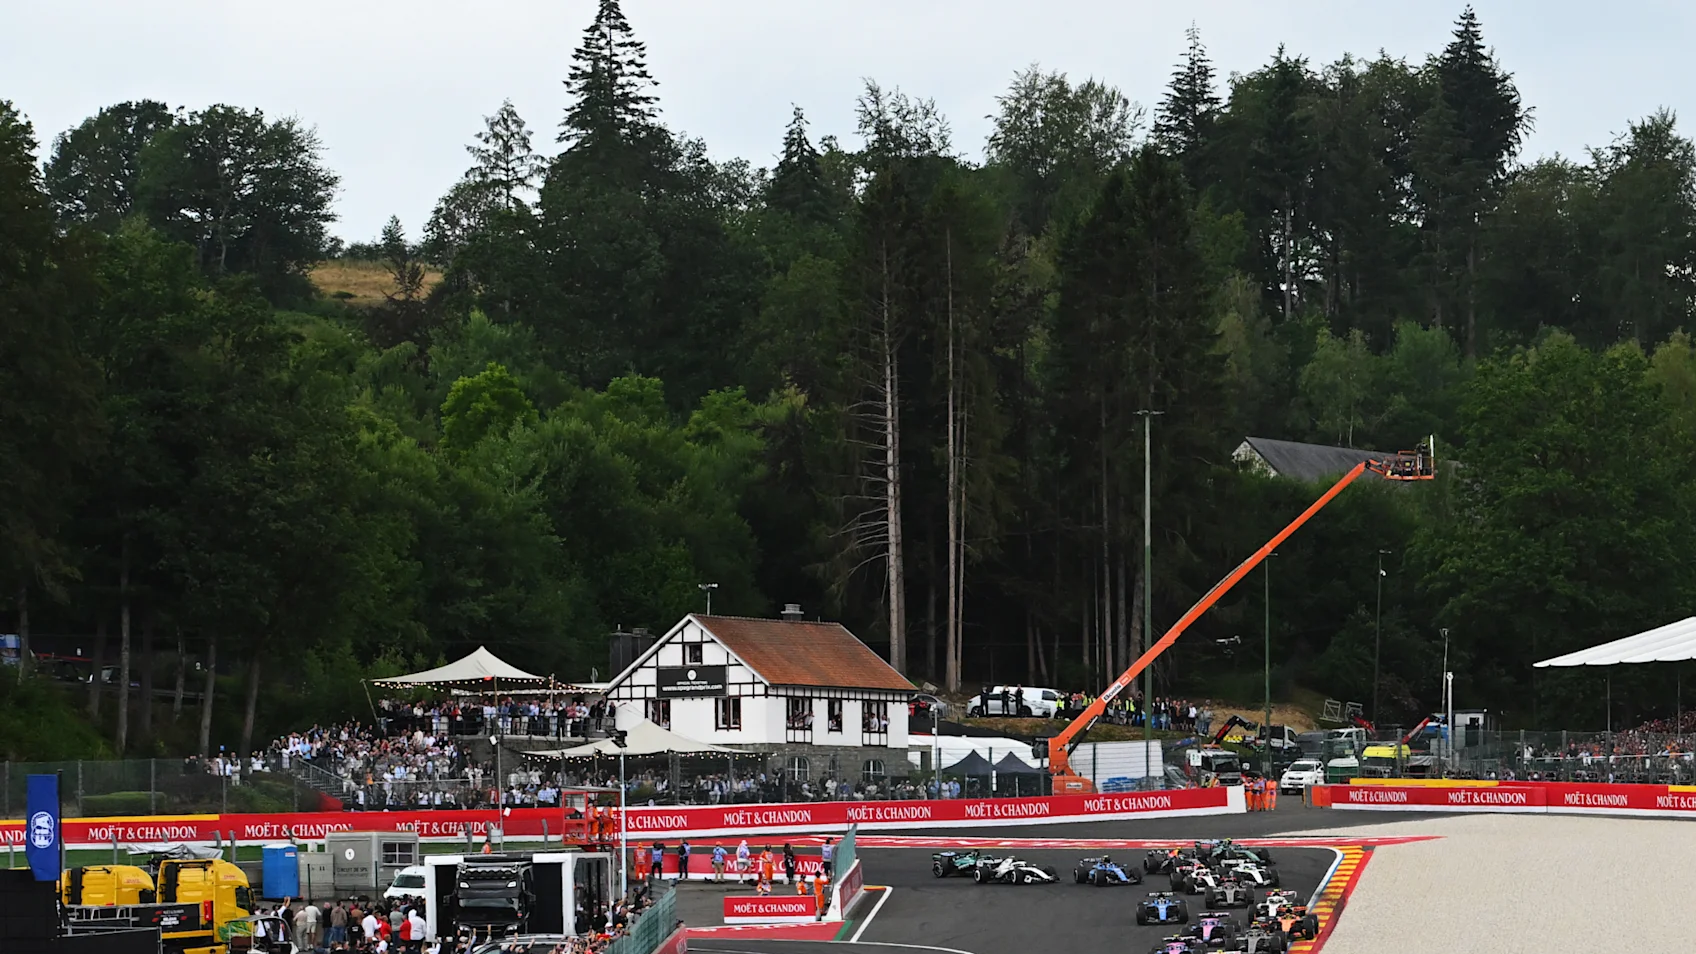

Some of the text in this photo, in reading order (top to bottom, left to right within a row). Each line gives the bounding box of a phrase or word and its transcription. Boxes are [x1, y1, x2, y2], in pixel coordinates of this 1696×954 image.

[1349, 790, 1407, 802] MOËT & CHANDON
[1448, 790, 1526, 804] MOËT & CHANDON
[1564, 791, 1628, 806] MOËT & CHANDON
[1657, 794, 1679, 808] MOËT
[1680, 796, 1686, 808] &
[965, 802, 1049, 817] MOËT & CHANDON
[1084, 796, 1171, 812] MOËT & CHANDON
[724, 810, 811, 825] MOËT & CHANDON
[847, 805, 931, 821] MOËT & CHANDON
[441, 821, 498, 833] CHADON
[628, 816, 635, 829] &
[635, 815, 687, 828] CHANDON
[88, 825, 197, 840] MOËT & CHANDON
[726, 857, 824, 874] MËT CANDO
[734, 902, 806, 913] MOËT & CHANDON
